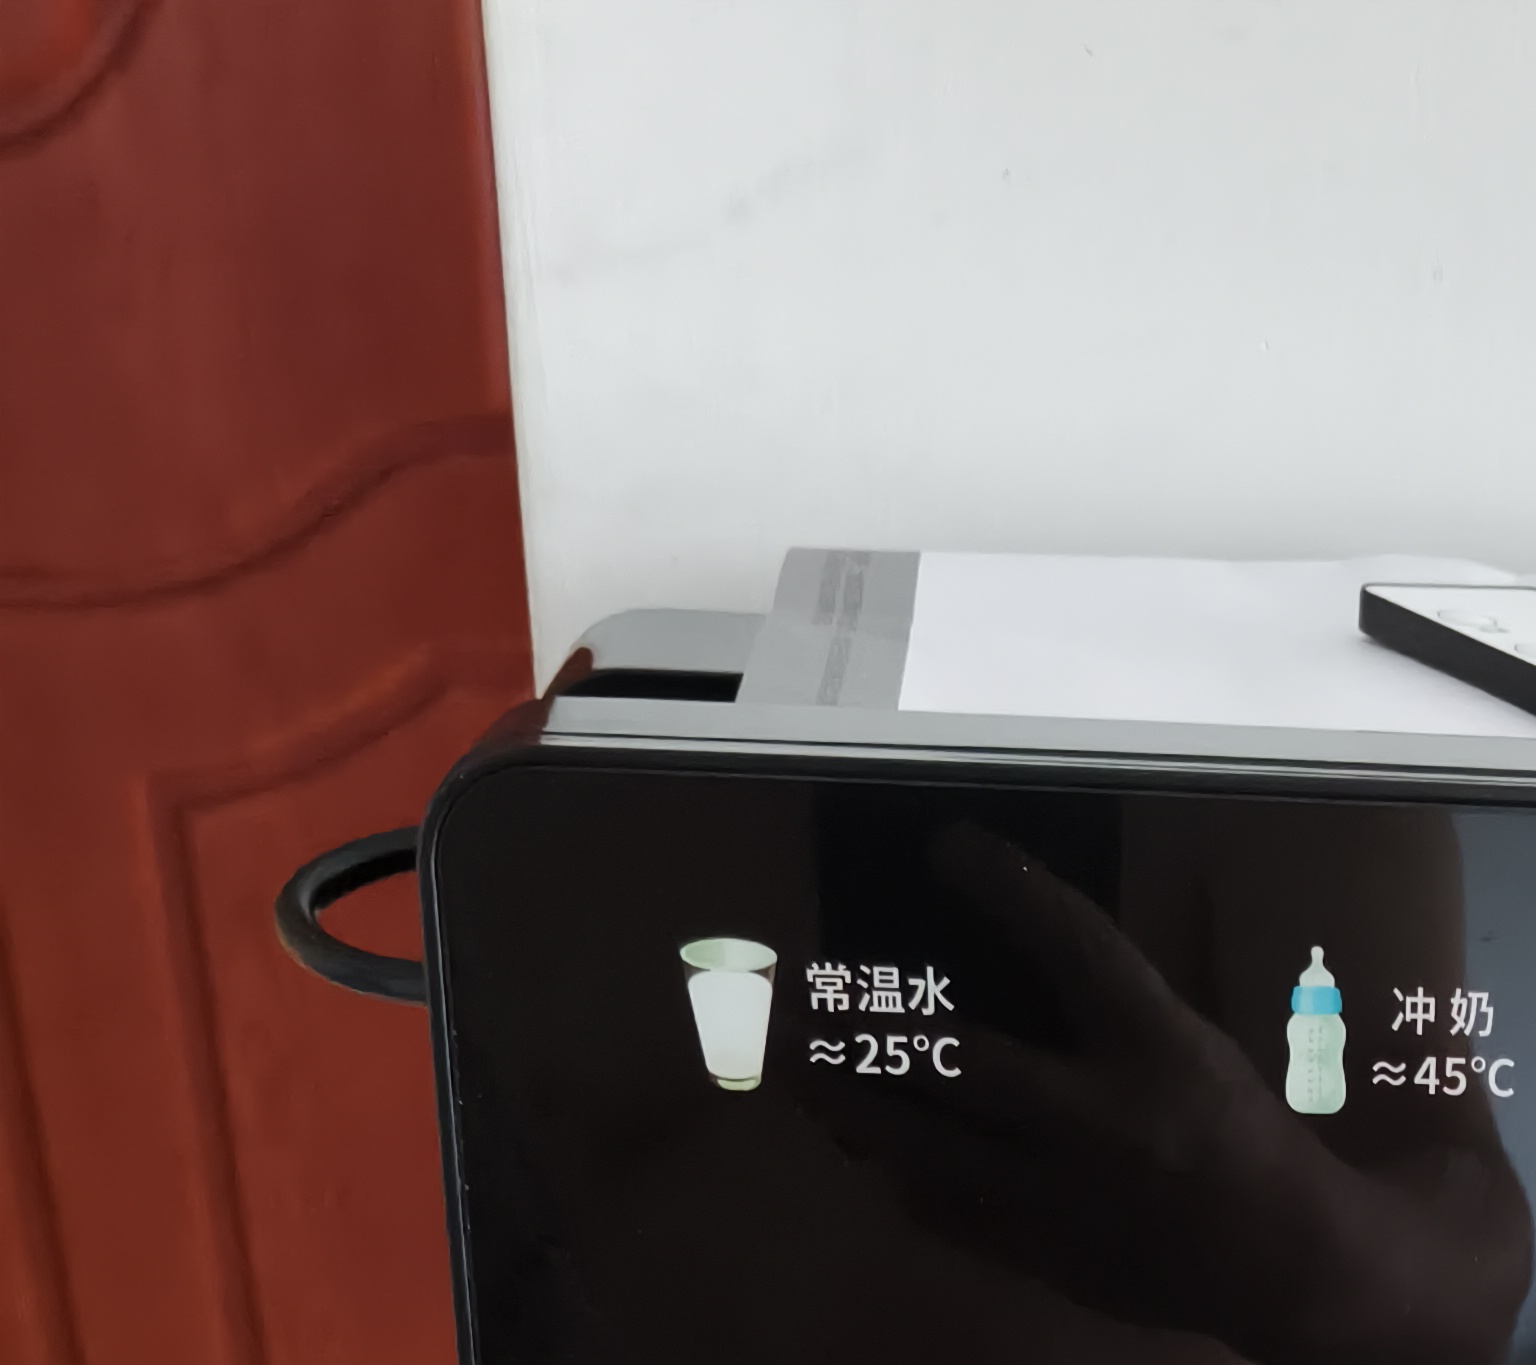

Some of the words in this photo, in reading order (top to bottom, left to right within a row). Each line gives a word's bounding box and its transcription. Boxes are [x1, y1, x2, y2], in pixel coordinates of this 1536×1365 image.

[806, 963, 955, 1016] 常温水
[1391, 987, 1495, 1038] 冲奶
